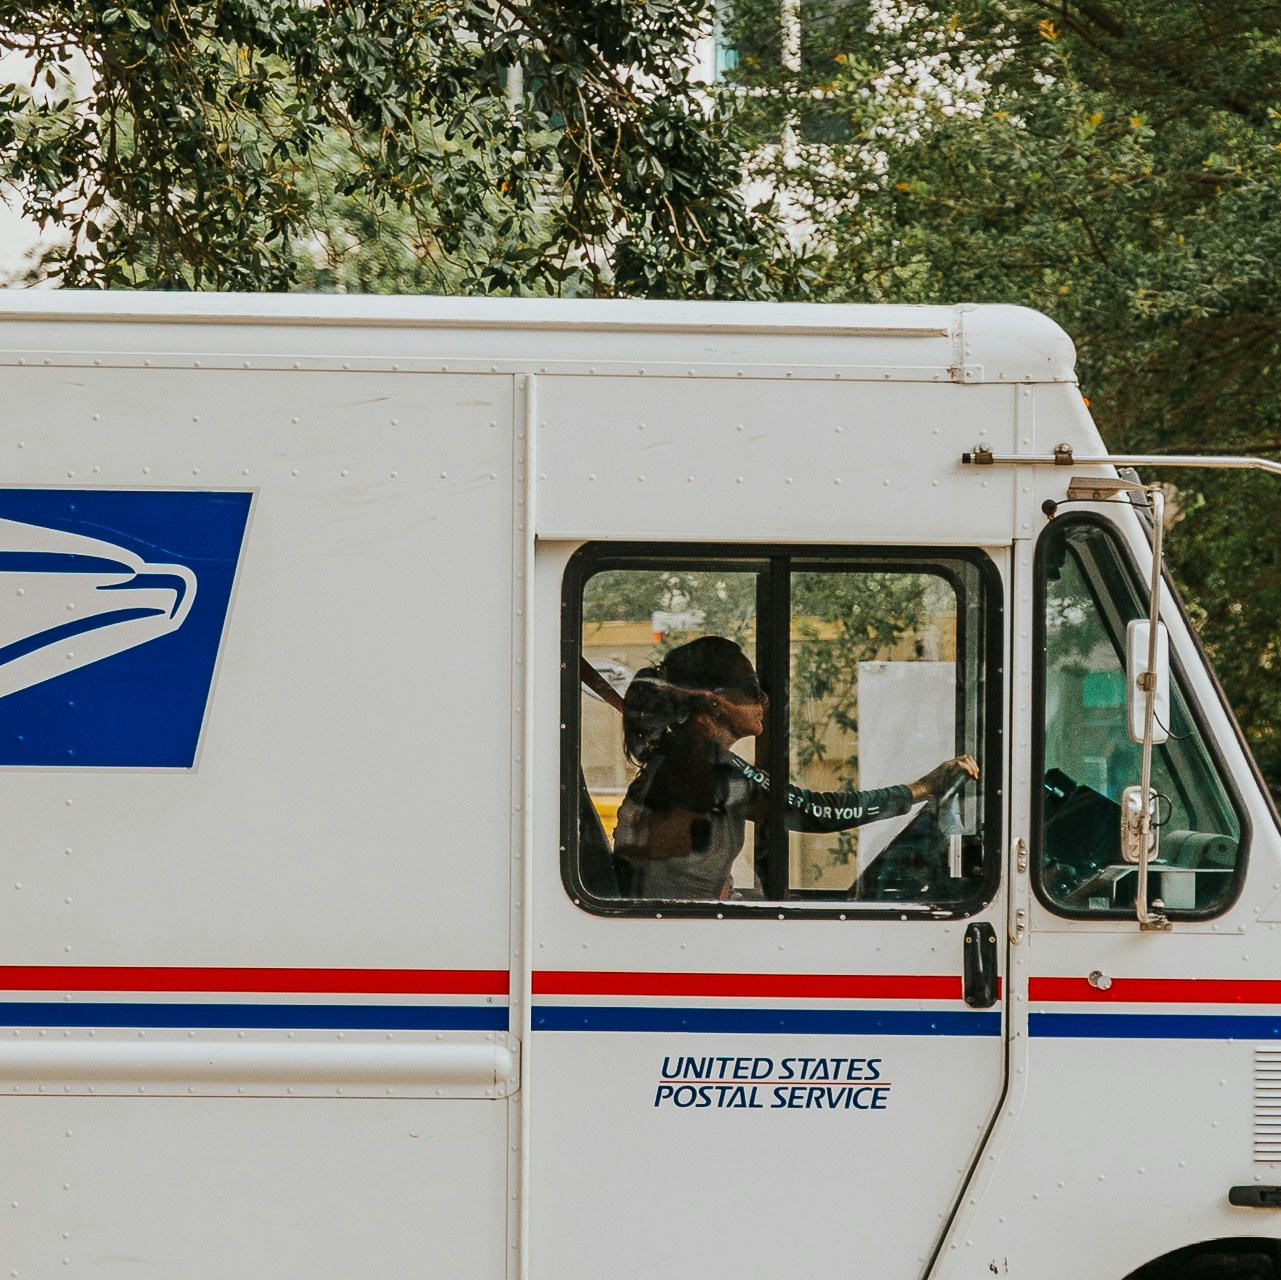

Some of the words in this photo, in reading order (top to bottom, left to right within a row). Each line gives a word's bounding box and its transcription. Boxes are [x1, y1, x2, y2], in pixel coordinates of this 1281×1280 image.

[835, 806, 863, 820] YOU
[661, 1056, 773, 1080] UNITED
[778, 1058, 882, 1081] STATES
[654, 1085, 763, 1108] POSTAL
[770, 1086, 891, 1110] SERVICE
